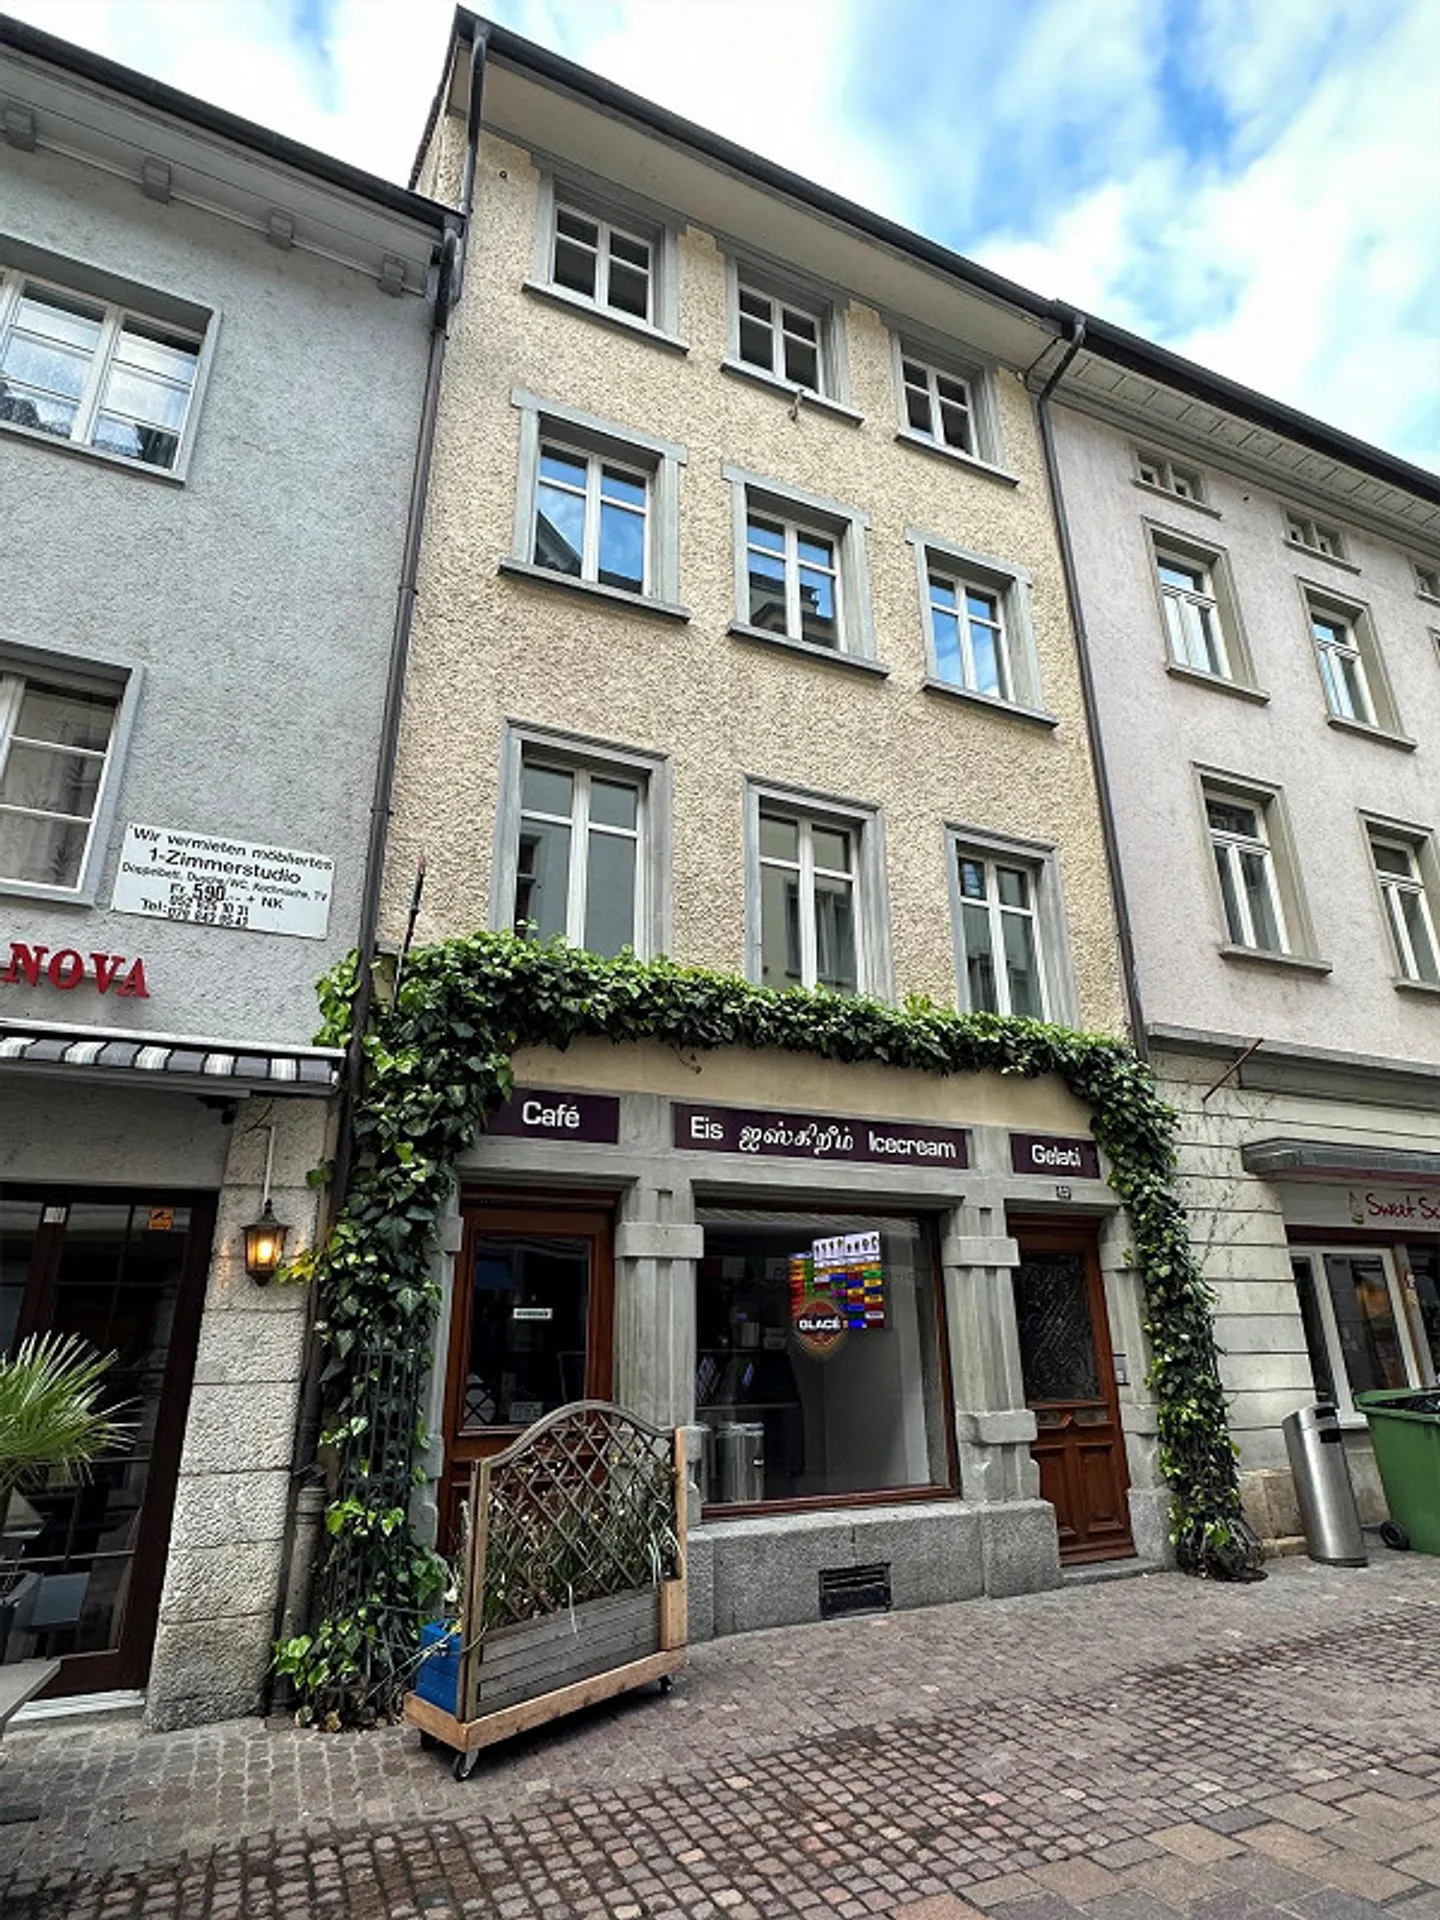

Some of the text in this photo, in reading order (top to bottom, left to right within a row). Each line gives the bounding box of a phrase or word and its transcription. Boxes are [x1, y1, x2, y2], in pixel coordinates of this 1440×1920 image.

[133, 827, 333, 871] Wir vermieten möbliertes
[149, 847, 301, 884] 1-Zimmerstudio
[261, 898, 283, 909] NK
[0, 943, 150, 998] NOVA
[523, 1101, 580, 1128] Café
[691, 1116, 724, 1140] Eis
[869, 1130, 956, 1158] Icecream
[1031, 1144, 1081, 1167] Gelati
[1366, 1192, 1416, 1218] Sweet
